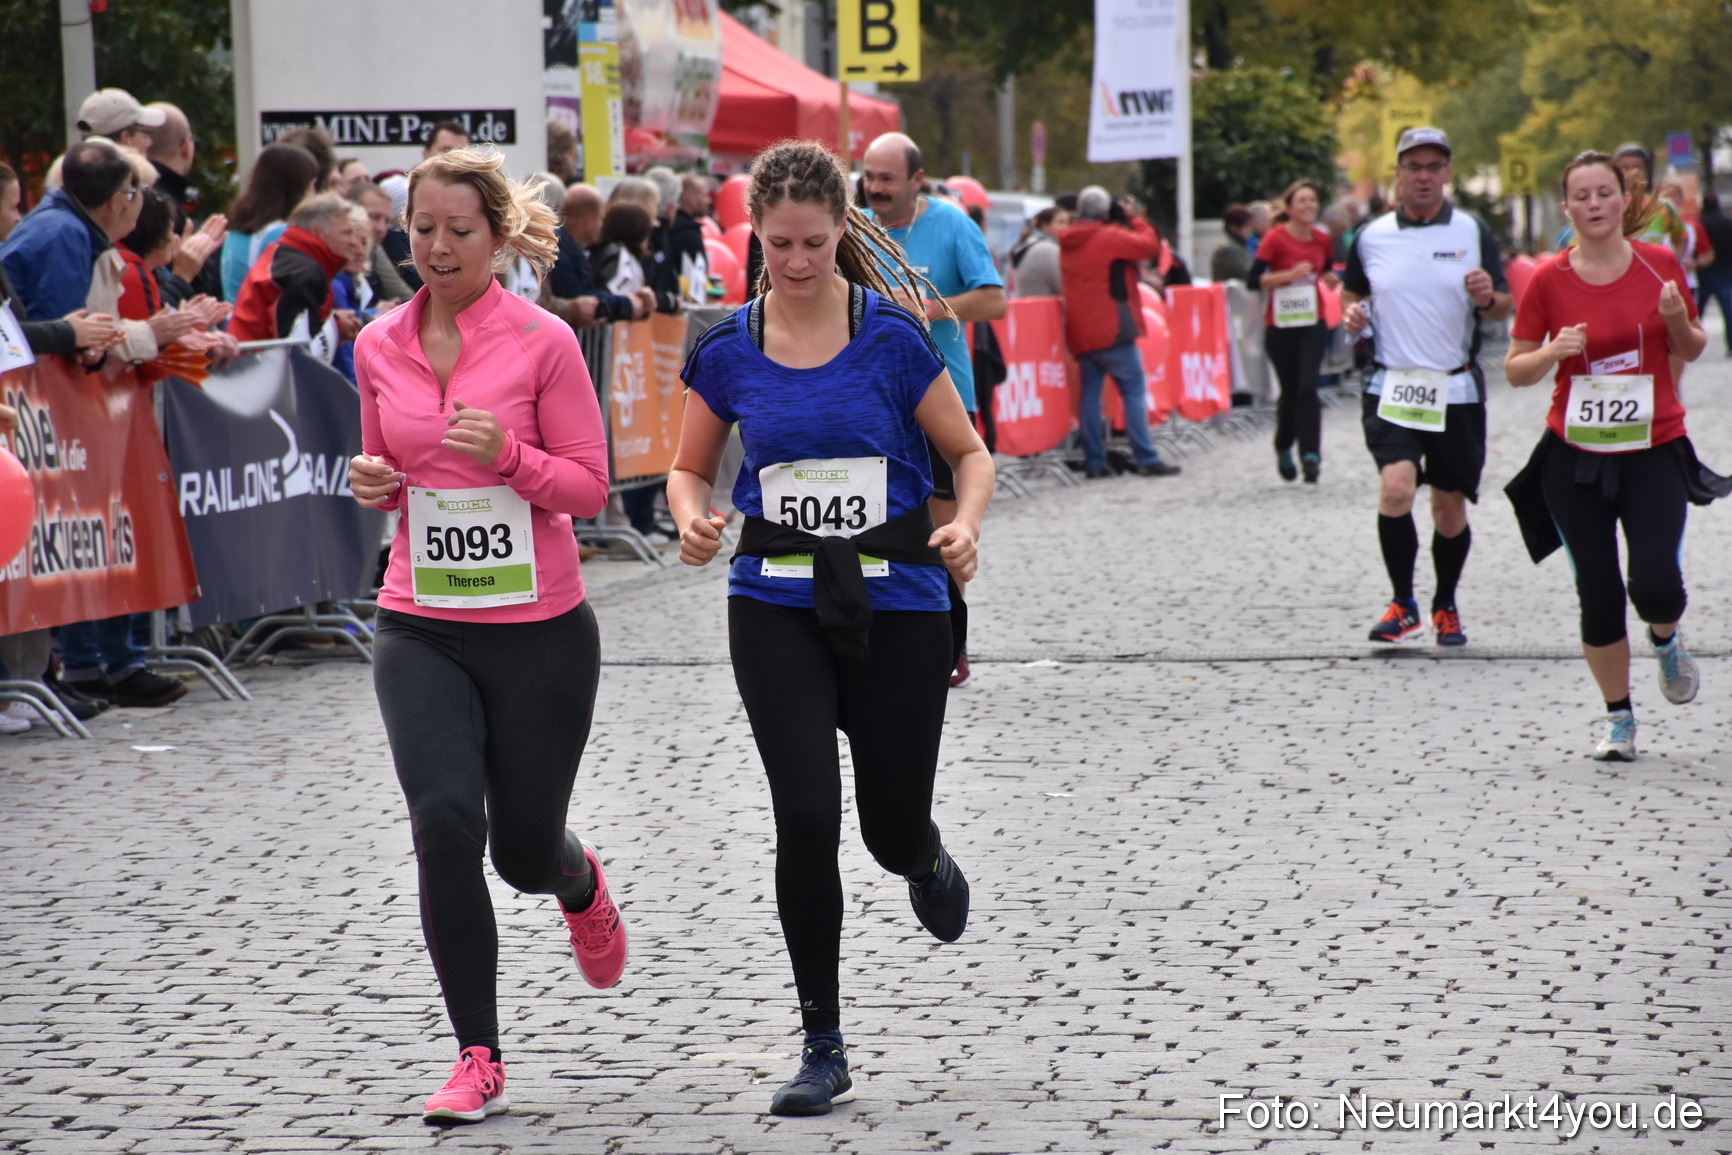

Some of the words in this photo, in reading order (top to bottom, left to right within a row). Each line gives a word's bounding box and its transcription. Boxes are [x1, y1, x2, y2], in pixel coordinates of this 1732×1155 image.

[860, 0, 898, 53] B
[1509, 159, 1529, 184] D
[1392, 385, 1437, 406] 5094
[1579, 400, 1639, 423] 5122
[806, 469, 850, 480] BOCK
[179, 458, 282, 517] RAIL.ONE
[447, 499, 492, 511] BOCK
[780, 495, 867, 531] 5043
[426, 523, 513, 562] 5093
[446, 575, 495, 588] Theresa
